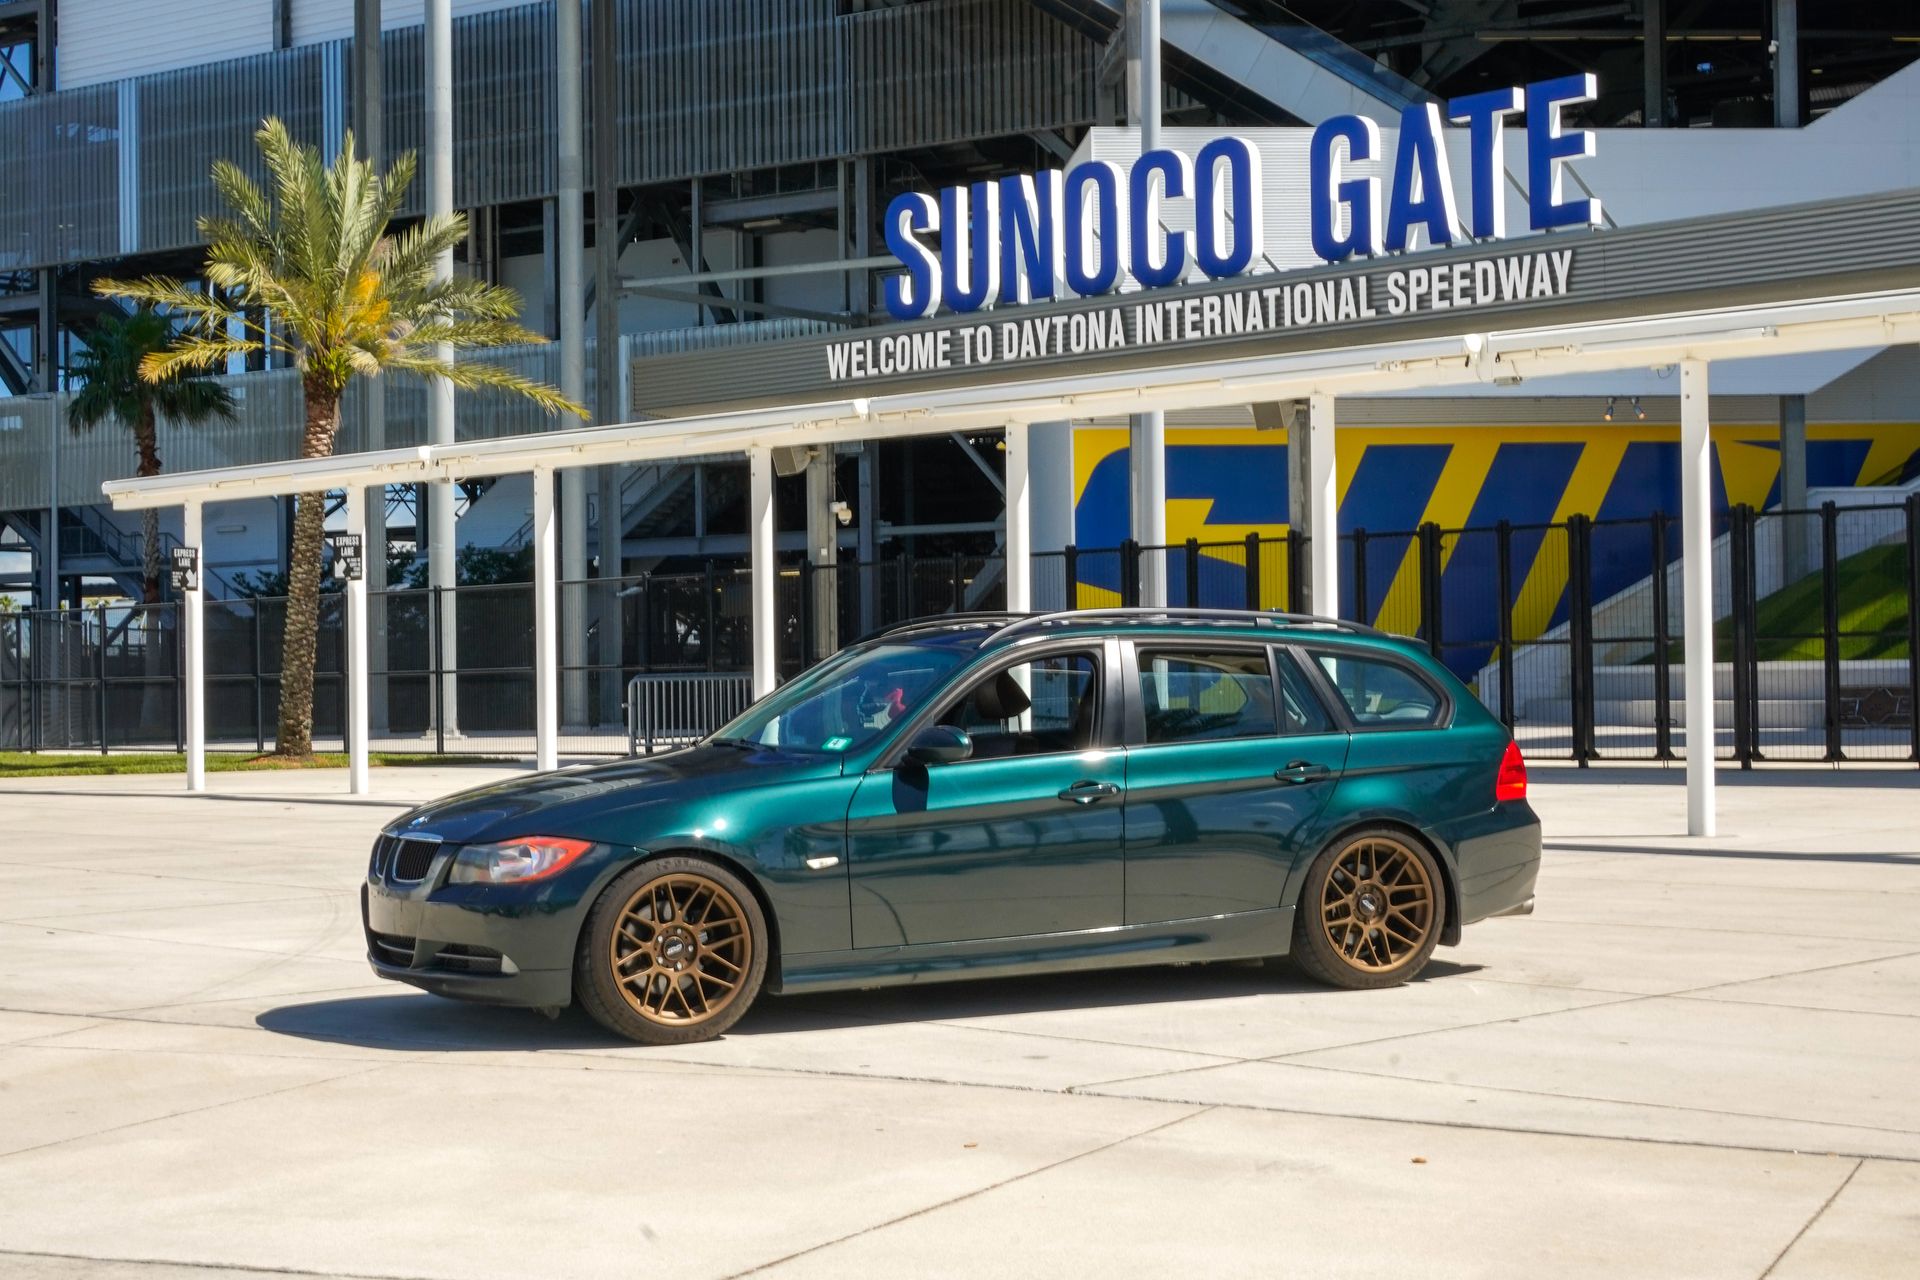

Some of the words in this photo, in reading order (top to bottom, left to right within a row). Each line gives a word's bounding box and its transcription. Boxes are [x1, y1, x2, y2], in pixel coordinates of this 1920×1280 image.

[884, 136, 1264, 320] SUNOCO
[1310, 73, 1602, 262] GATE
[826, 330, 952, 381] WELCOME
[959, 325, 993, 365] TO
[1002, 308, 1126, 361] DAYTONA
[1135, 275, 1377, 345] INTERNATIONAL
[1387, 249, 1573, 316] SPEEDWAY
[335, 535, 360, 547] EXPRESS
[173, 548, 196, 559] EXPRESS
[340, 546, 355, 557] LANE
[178, 557, 191, 567] LANE
